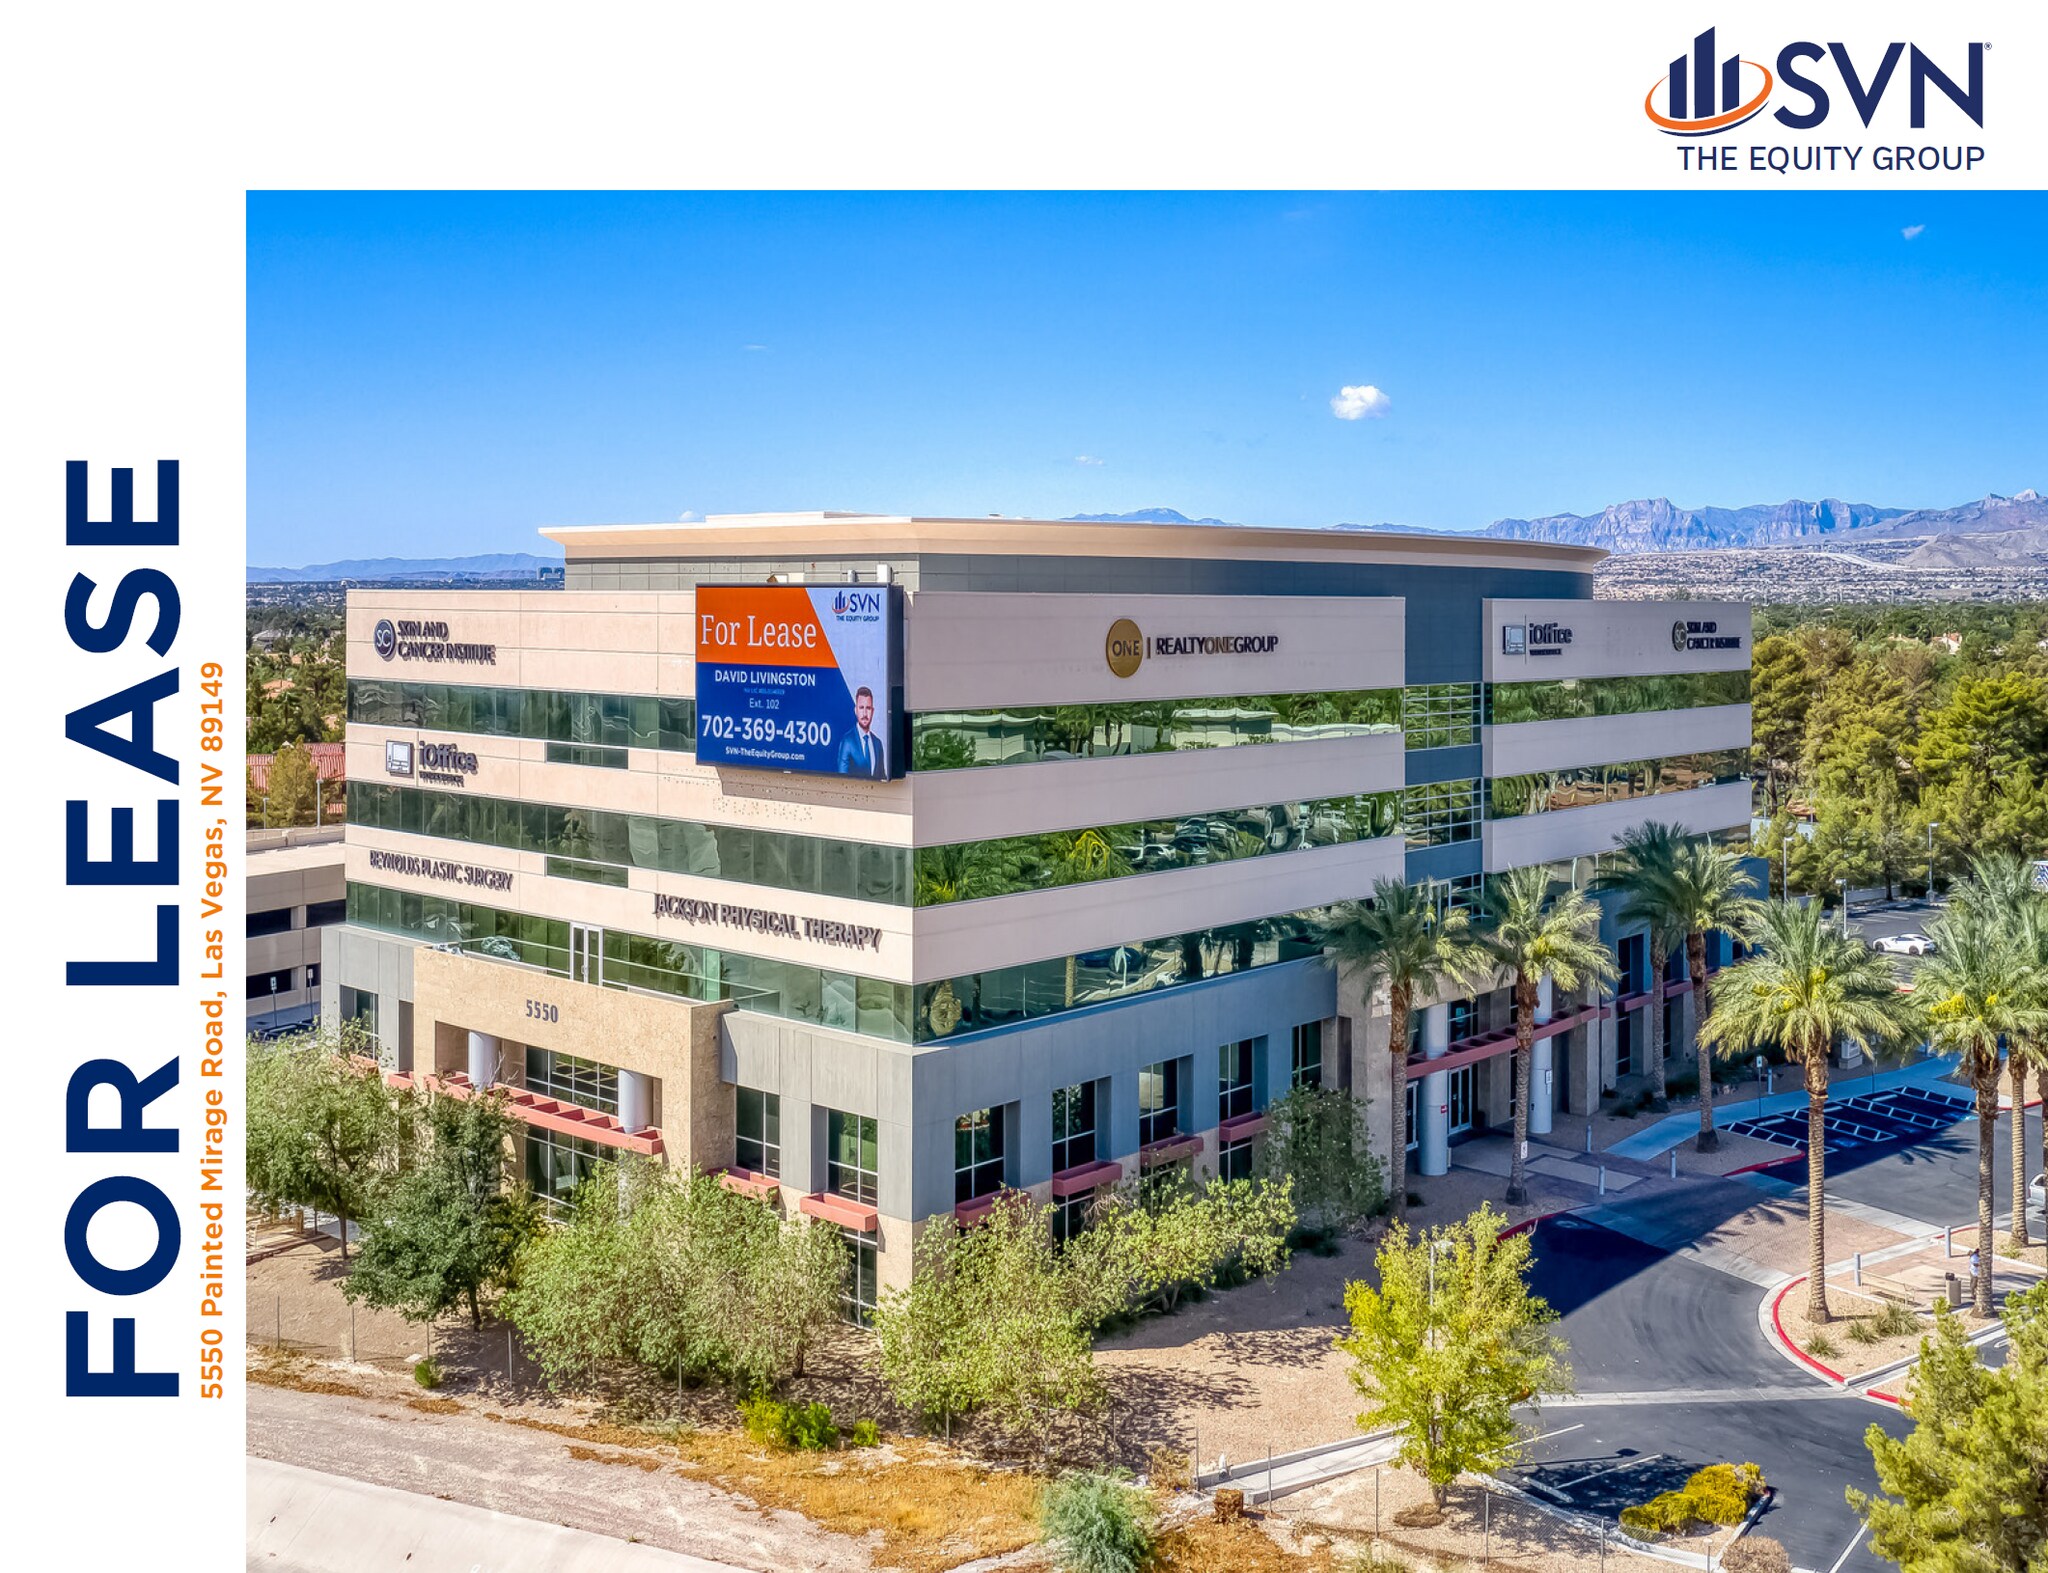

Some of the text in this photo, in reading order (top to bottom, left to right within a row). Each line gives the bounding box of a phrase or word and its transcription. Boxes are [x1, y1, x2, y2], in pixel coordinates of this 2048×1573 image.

[849, 593, 880, 613] SVN
[376, 629, 391, 647] SC
[422, 622, 449, 641] AND
[701, 614, 817, 648] For Lease
[1529, 622, 1573, 645] iOffice
[398, 641, 445, 662] CANCER
[1112, 640, 1140, 657] ONE
[715, 670, 816, 687] DAVID LIVINGSTON
[749, 697, 780, 710] Ext. 102
[701, 715, 832, 746] 702-369-4300
[419, 740, 479, 775] iOffice
[725, 746, 805, 761] SVN-TheEquityGroup.com
[421, 859, 463, 883] PLASTIC
[464, 865, 514, 892] SURGERY
[653, 892, 883, 953] JACKSON PHYSICAL THERAPY
[526, 999, 558, 1023] 5550
